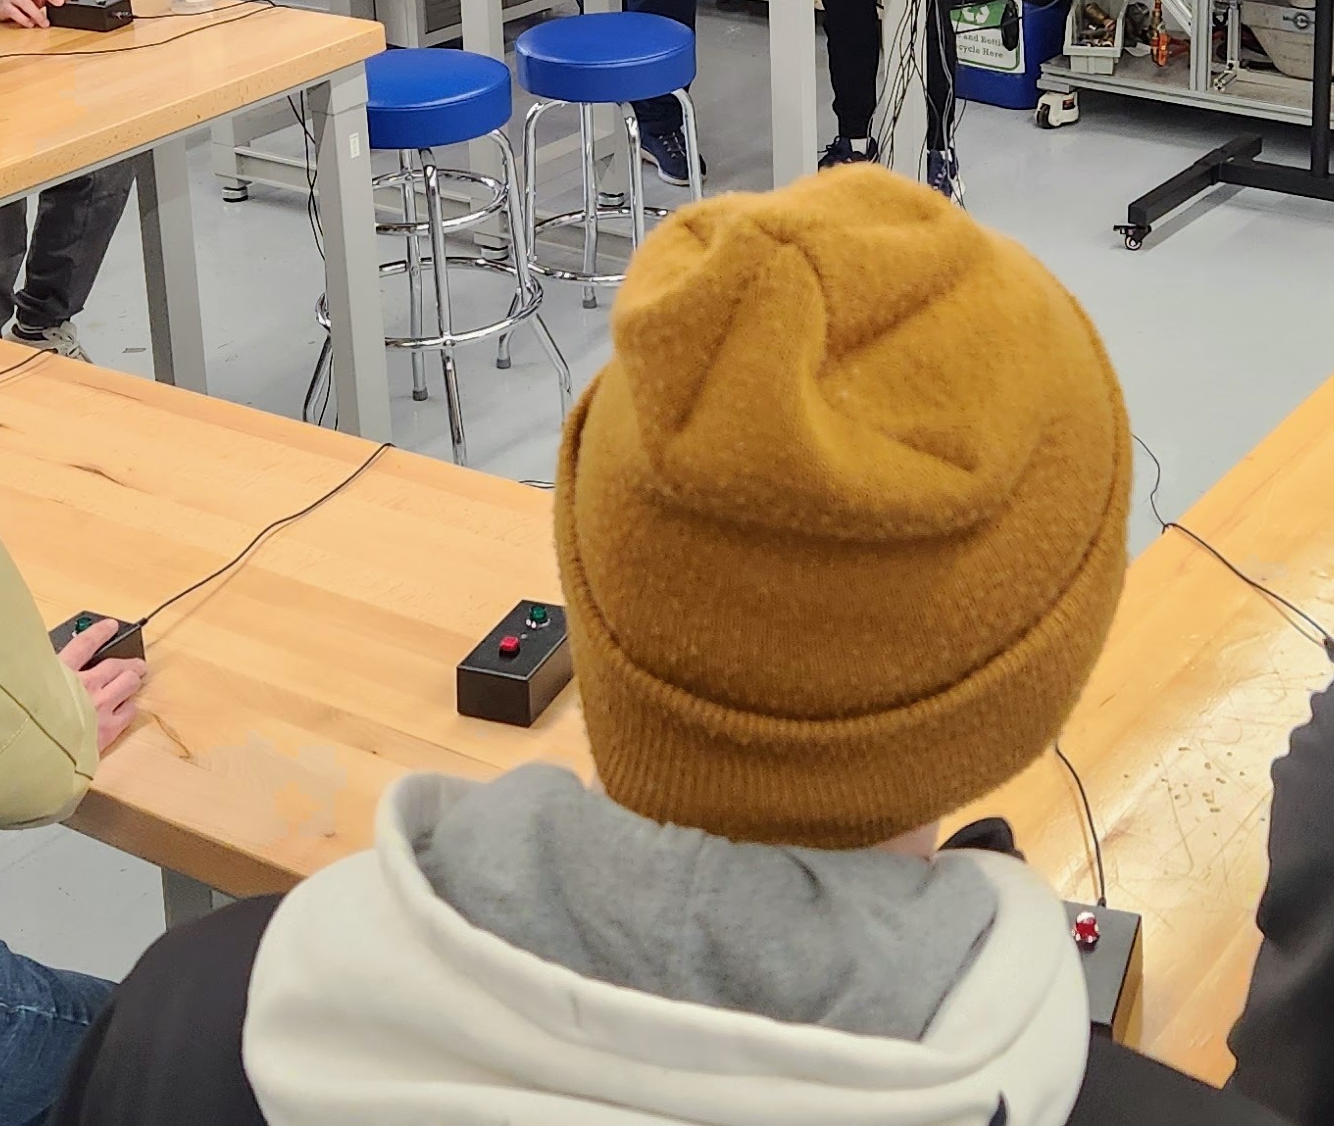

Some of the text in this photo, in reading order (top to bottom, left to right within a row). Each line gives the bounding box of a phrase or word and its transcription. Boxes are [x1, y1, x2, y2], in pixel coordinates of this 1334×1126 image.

[963, 34, 1004, 47] and Bottl
[958, 44, 1004, 59] cycle Here
